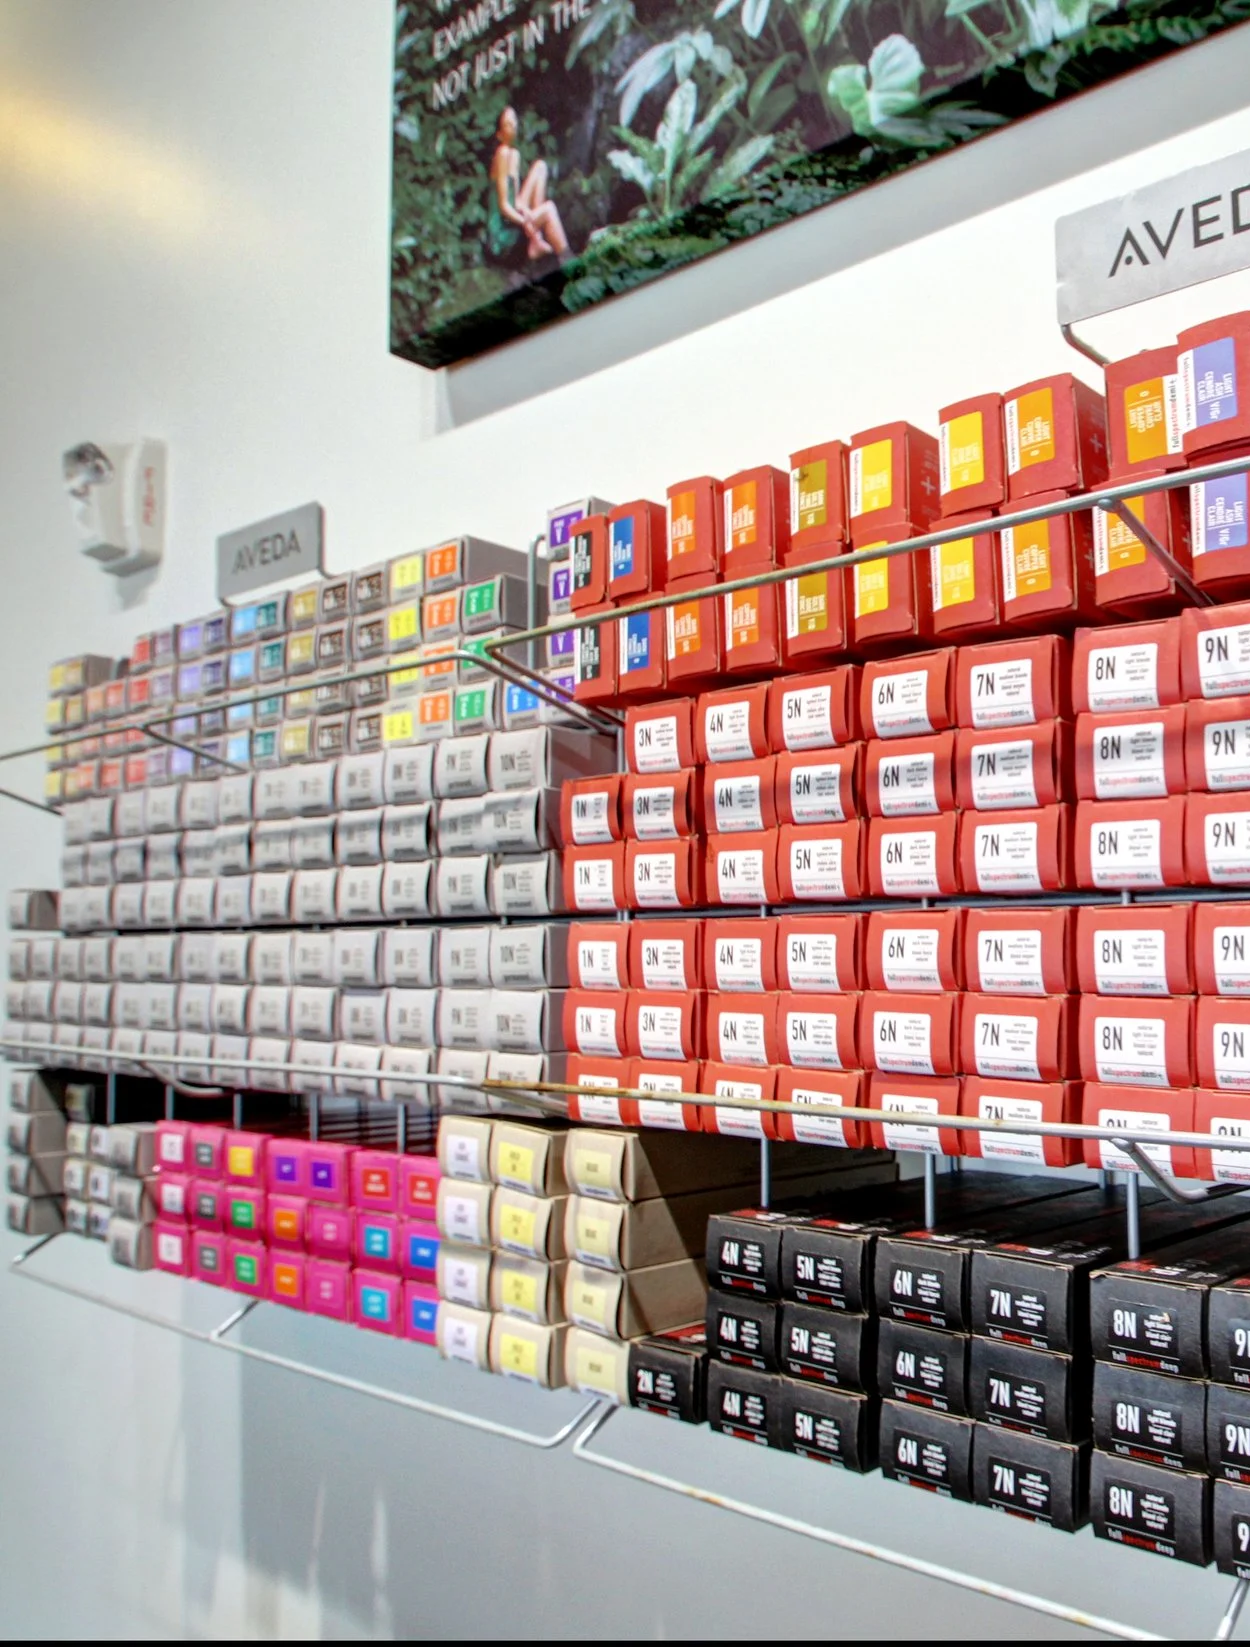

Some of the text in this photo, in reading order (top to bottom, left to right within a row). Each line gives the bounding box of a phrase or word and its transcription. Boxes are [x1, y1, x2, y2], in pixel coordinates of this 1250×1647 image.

[432, 61, 471, 111] NOT
[473, 30, 518, 89] JUST
[523, 14, 545, 52] IN
[232, 529, 301, 574] AVEDA
[1204, 635, 1229, 663] 9N
[1095, 656, 1116, 681] 8N
[877, 680, 895, 705] 6N
[976, 672, 995, 696] 7N
[786, 696, 801, 719] 5N
[710, 712, 724, 734] 4N
[638, 726, 652, 748] 3N
[1100, 736, 1122, 760] 8N
[1212, 728, 1236, 756] 9N
[575, 796, 587, 817] 1N
[582, 947, 594, 968] 1N
[645, 944, 659, 966] 3N
[719, 943, 734, 966] 4N
[887, 935, 905, 959] 6N
[984, 939, 1003, 962] 7N
[1102, 939, 1123, 964] 8N
[1221, 935, 1245, 961] 9N
[721, 1240, 739, 1266] 4N
[796, 1254, 815, 1281] 5N
[893, 1269, 912, 1298] 6N
[990, 1288, 1011, 1319] 7N
[1113, 1309, 1137, 1339] 8N
[896, 1350, 915, 1379] 6N
[636, 1368, 654, 1395] 2N
[989, 1378, 1010, 1408] 7N
[1116, 1402, 1140, 1434] 8N
